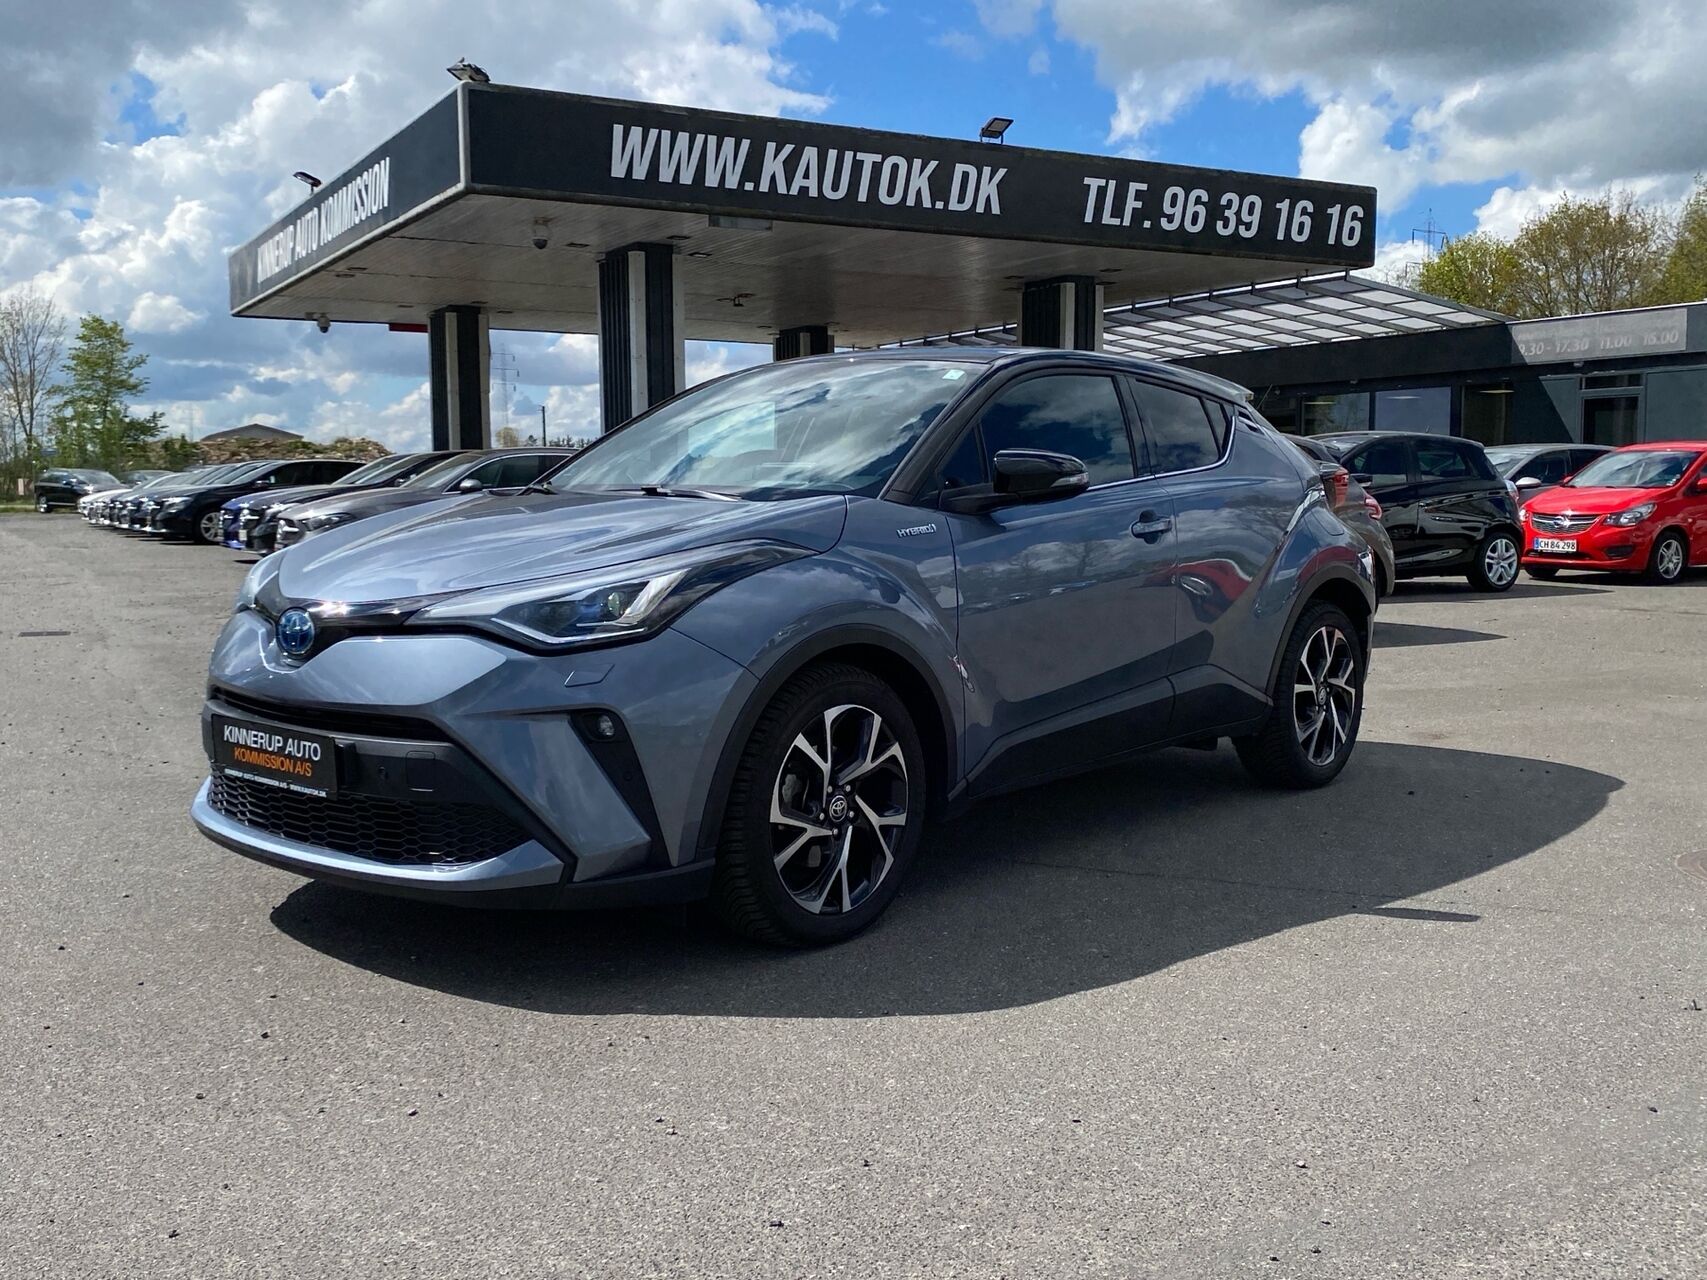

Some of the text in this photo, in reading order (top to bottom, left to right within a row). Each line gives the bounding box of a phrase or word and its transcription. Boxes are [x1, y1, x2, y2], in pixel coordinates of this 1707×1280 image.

[611, 124, 1008, 215] WWW.KAUTOK.DK
[294, 207, 319, 261] AUTO
[320, 156, 390, 246] KOMMISSION
[1083, 177, 1364, 247] TLF. 96 39 16 16
[1540, 540, 1576, 550] CH 84 298
[223, 725, 321, 761] KINNERUP AUTO
[234, 747, 312, 777] KOMMISSION A/S
